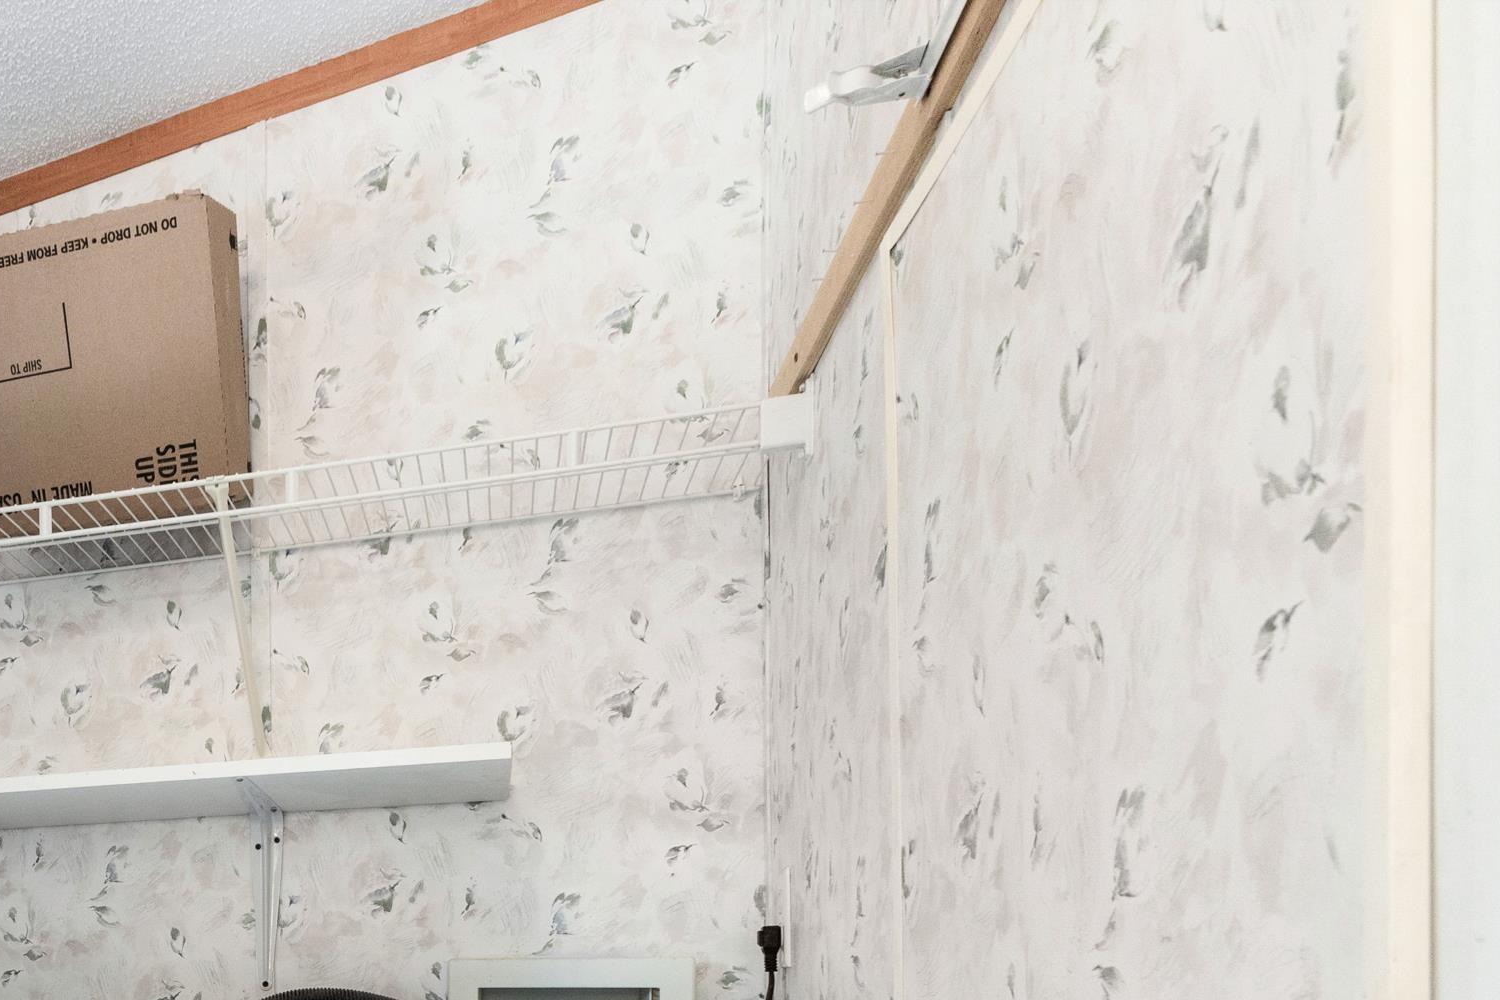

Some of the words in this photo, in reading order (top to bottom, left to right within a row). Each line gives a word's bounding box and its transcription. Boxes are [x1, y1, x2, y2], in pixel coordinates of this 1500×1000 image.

[134, 220, 158, 238] NOT
[161, 216, 178, 231] DO
[100, 226, 131, 245] DROP
[26, 244, 58, 262] FROM
[60, 236, 89, 254] KEEP
[10, 363, 21, 376] TO
[22, 358, 42, 373] SHIP
[134, 456, 156, 484] UP
[31, 488, 47, 503] IN
[50, 480, 94, 501] MADE
